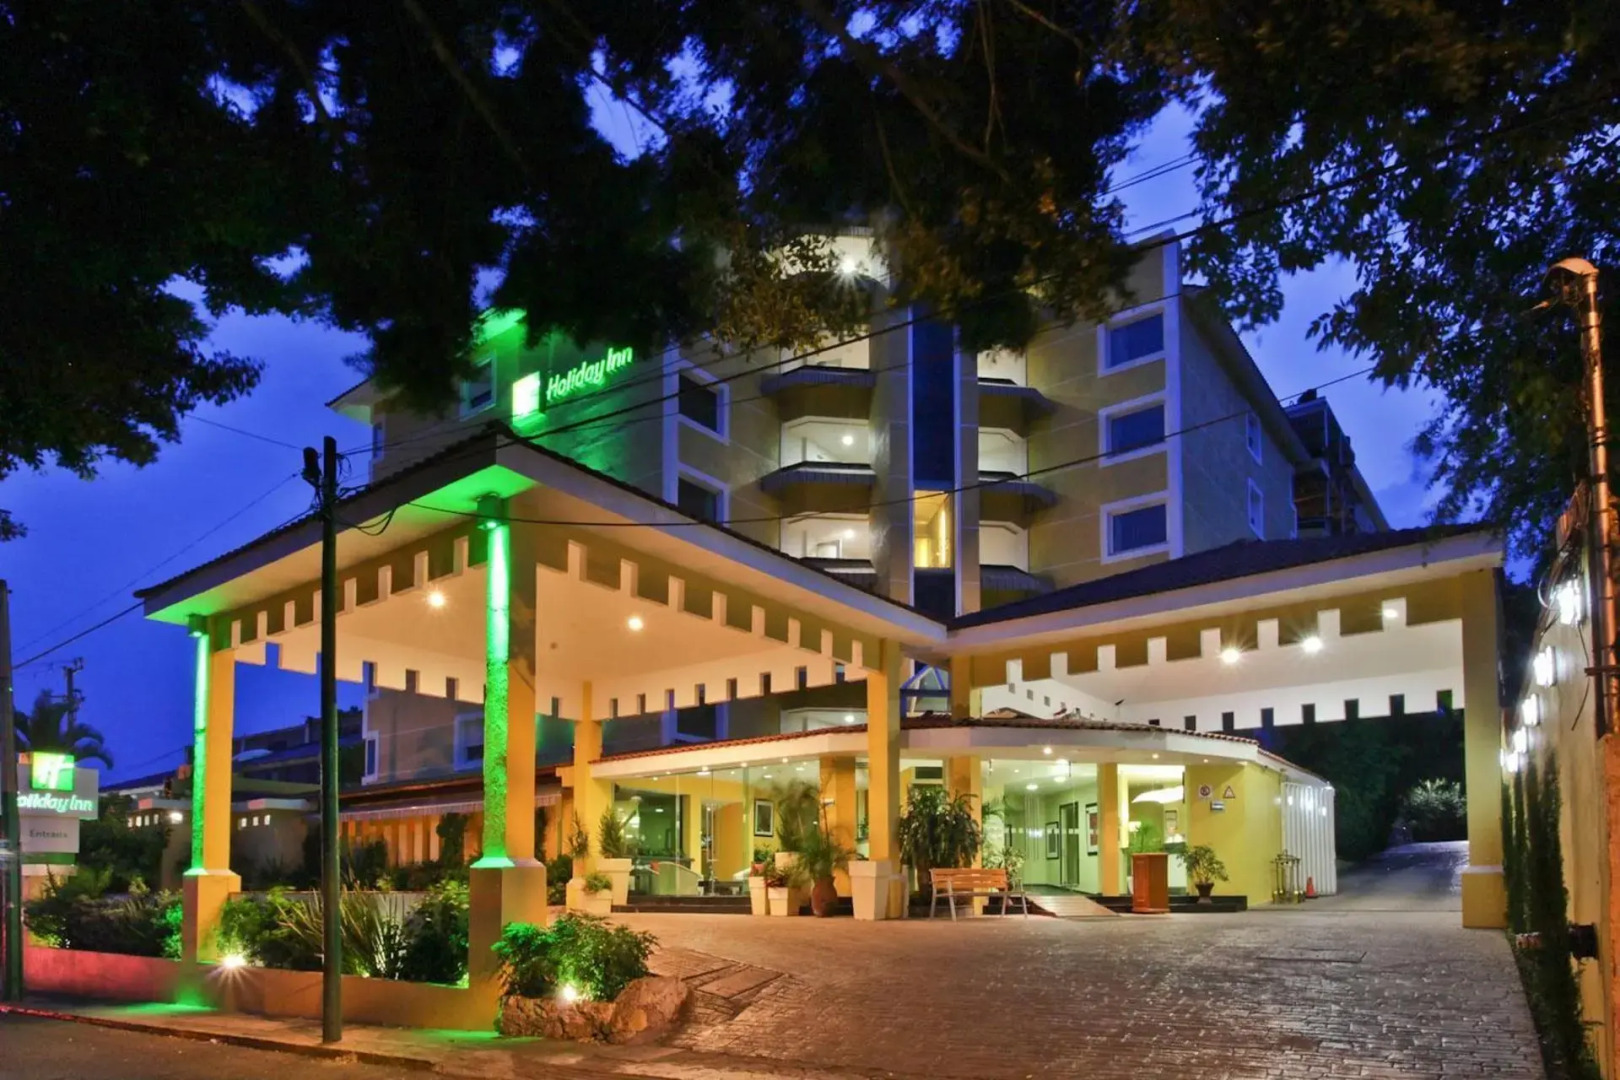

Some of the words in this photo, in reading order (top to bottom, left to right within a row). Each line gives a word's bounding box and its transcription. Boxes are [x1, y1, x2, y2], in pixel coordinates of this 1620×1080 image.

[546, 360, 606, 401] Holiday
[606, 347, 633, 372] Inn
[16, 792, 69, 813] oliday
[69, 794, 94, 811] Inn
